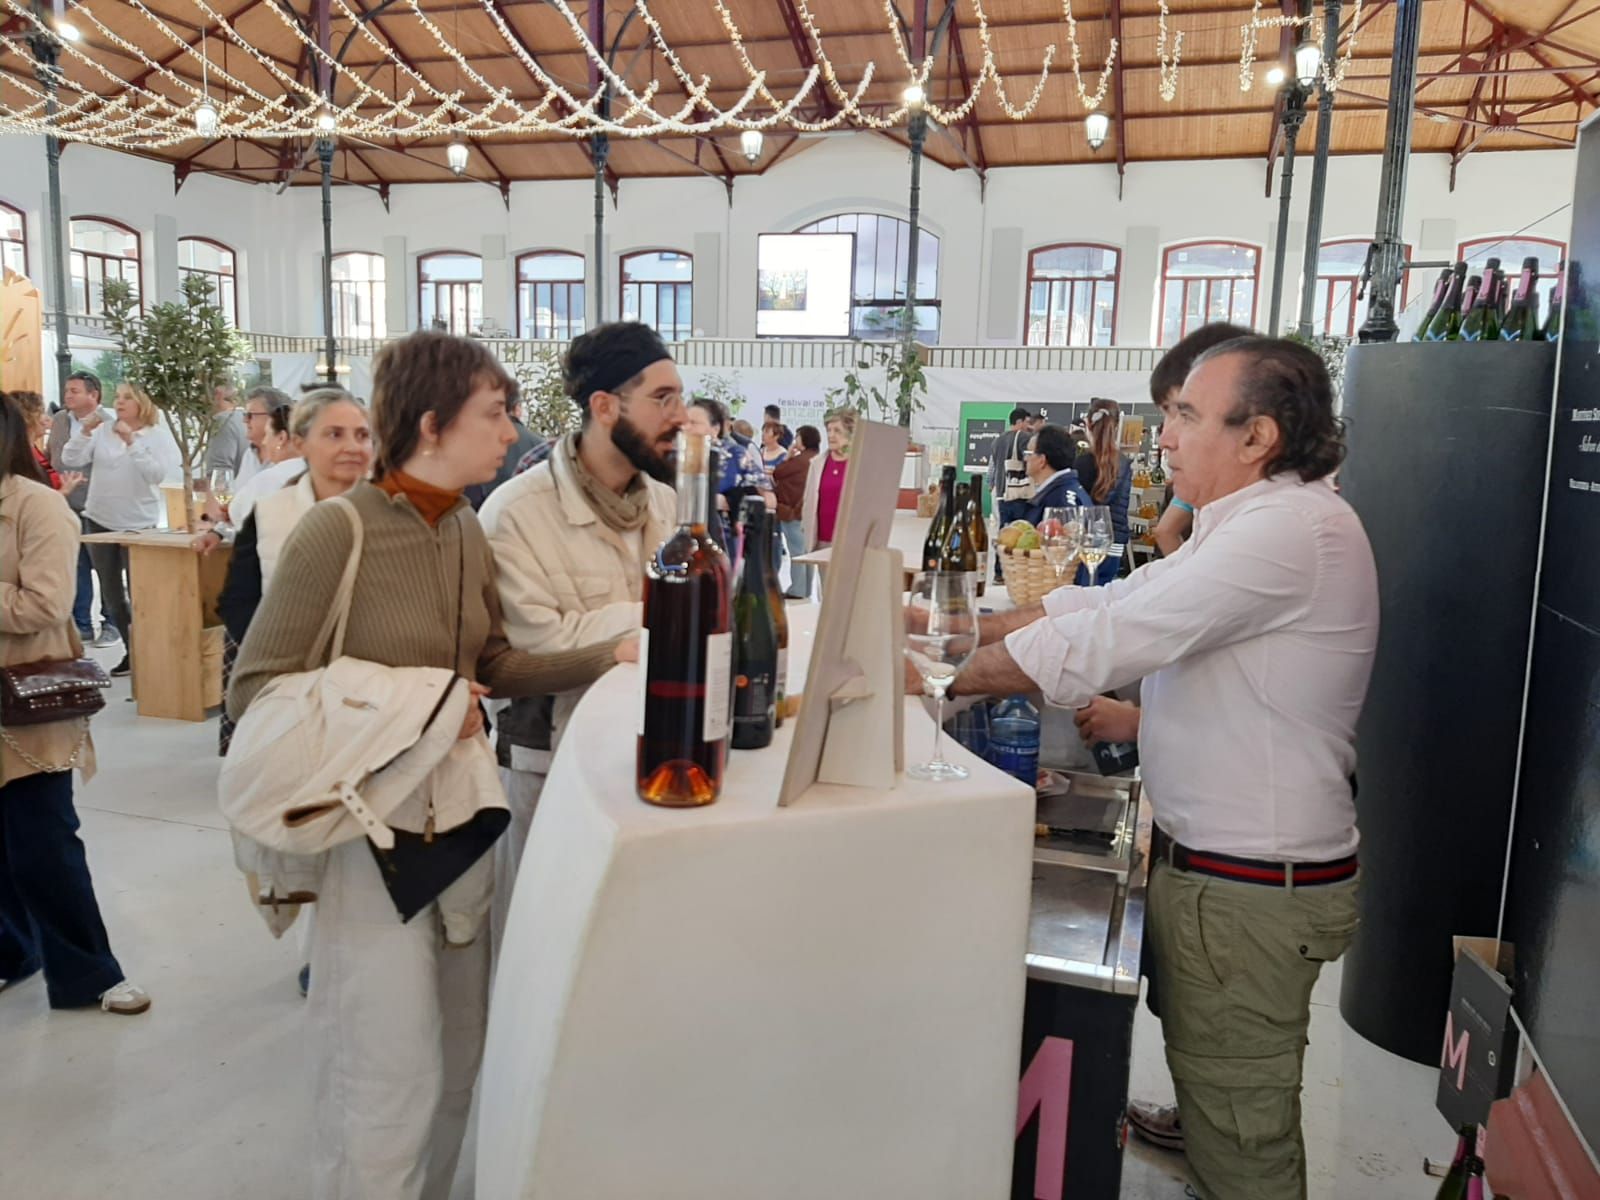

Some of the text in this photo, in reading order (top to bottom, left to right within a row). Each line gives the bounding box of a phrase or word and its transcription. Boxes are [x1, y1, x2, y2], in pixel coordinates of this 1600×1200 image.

[778, 397, 825, 407] festival de
[1440, 1009, 1470, 1090] M
